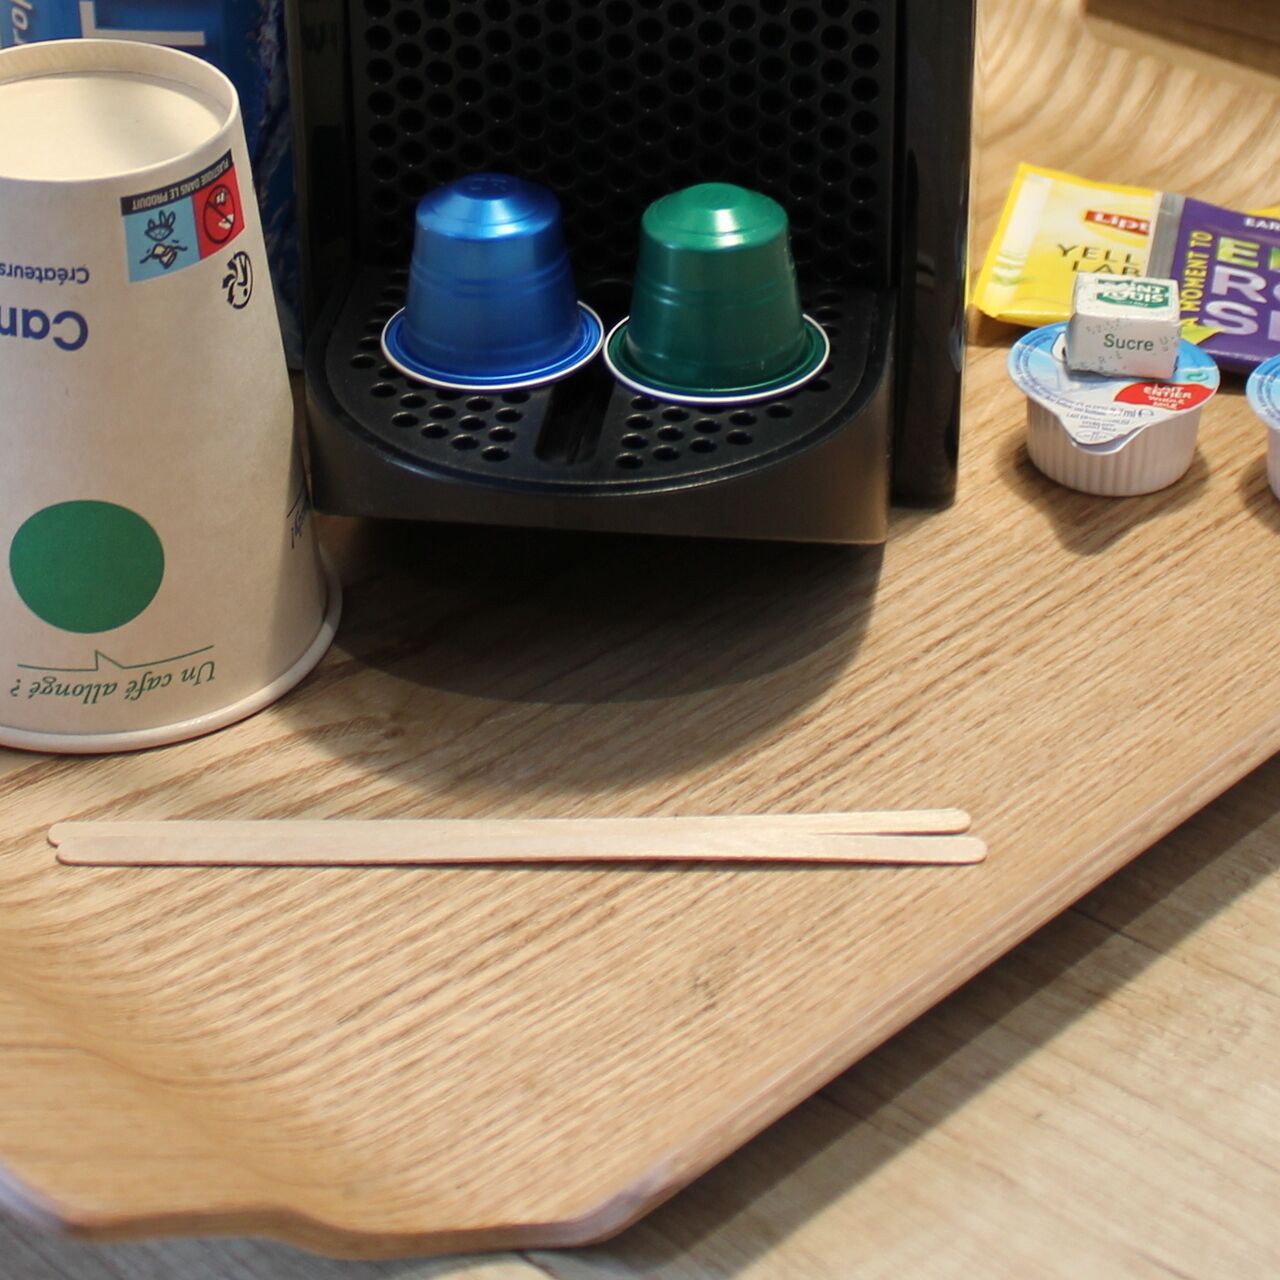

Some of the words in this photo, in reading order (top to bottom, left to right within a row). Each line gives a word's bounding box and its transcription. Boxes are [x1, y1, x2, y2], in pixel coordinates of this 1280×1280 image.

[169, 186, 180, 200] LE
[180, 177, 200, 195] DANS
[131, 192, 168, 211] PRODUIT
[1190, 230, 1214, 247] TO
[1057, 243, 1140, 266] YELL
[1180, 251, 1210, 312] MOMENT
[1103, 333, 1154, 351] Sucre
[181, 660, 216, 686] Un
[10, 678, 22, 697] ?
[28, 675, 118, 705] allongé
[124, 671, 173, 701] café
